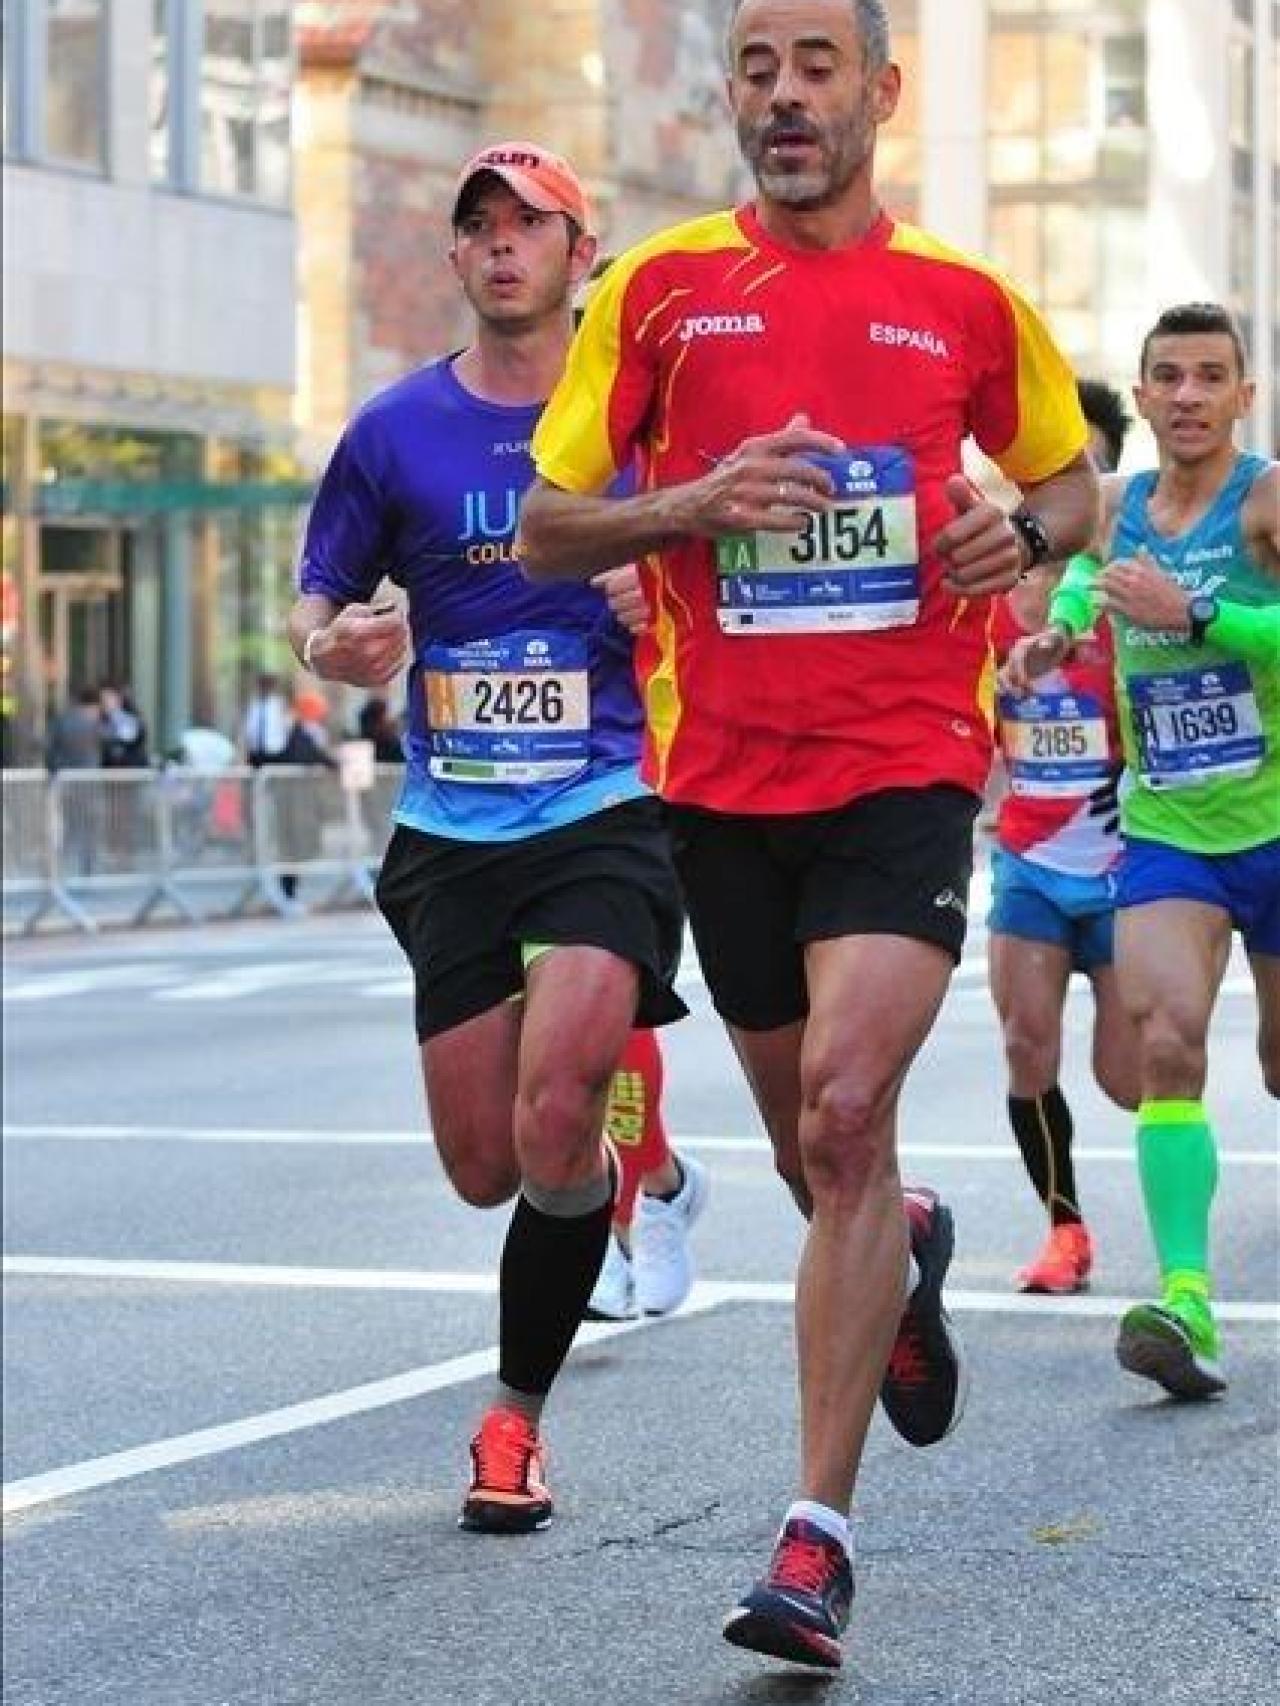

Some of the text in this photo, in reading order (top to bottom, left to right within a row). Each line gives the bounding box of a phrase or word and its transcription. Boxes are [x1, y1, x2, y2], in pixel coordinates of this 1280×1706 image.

[790, 506, 888, 564] 3154
[475, 679, 563, 724] 2426
[1170, 701, 1239, 745] 1639
[1030, 725, 1088, 758] 2185
